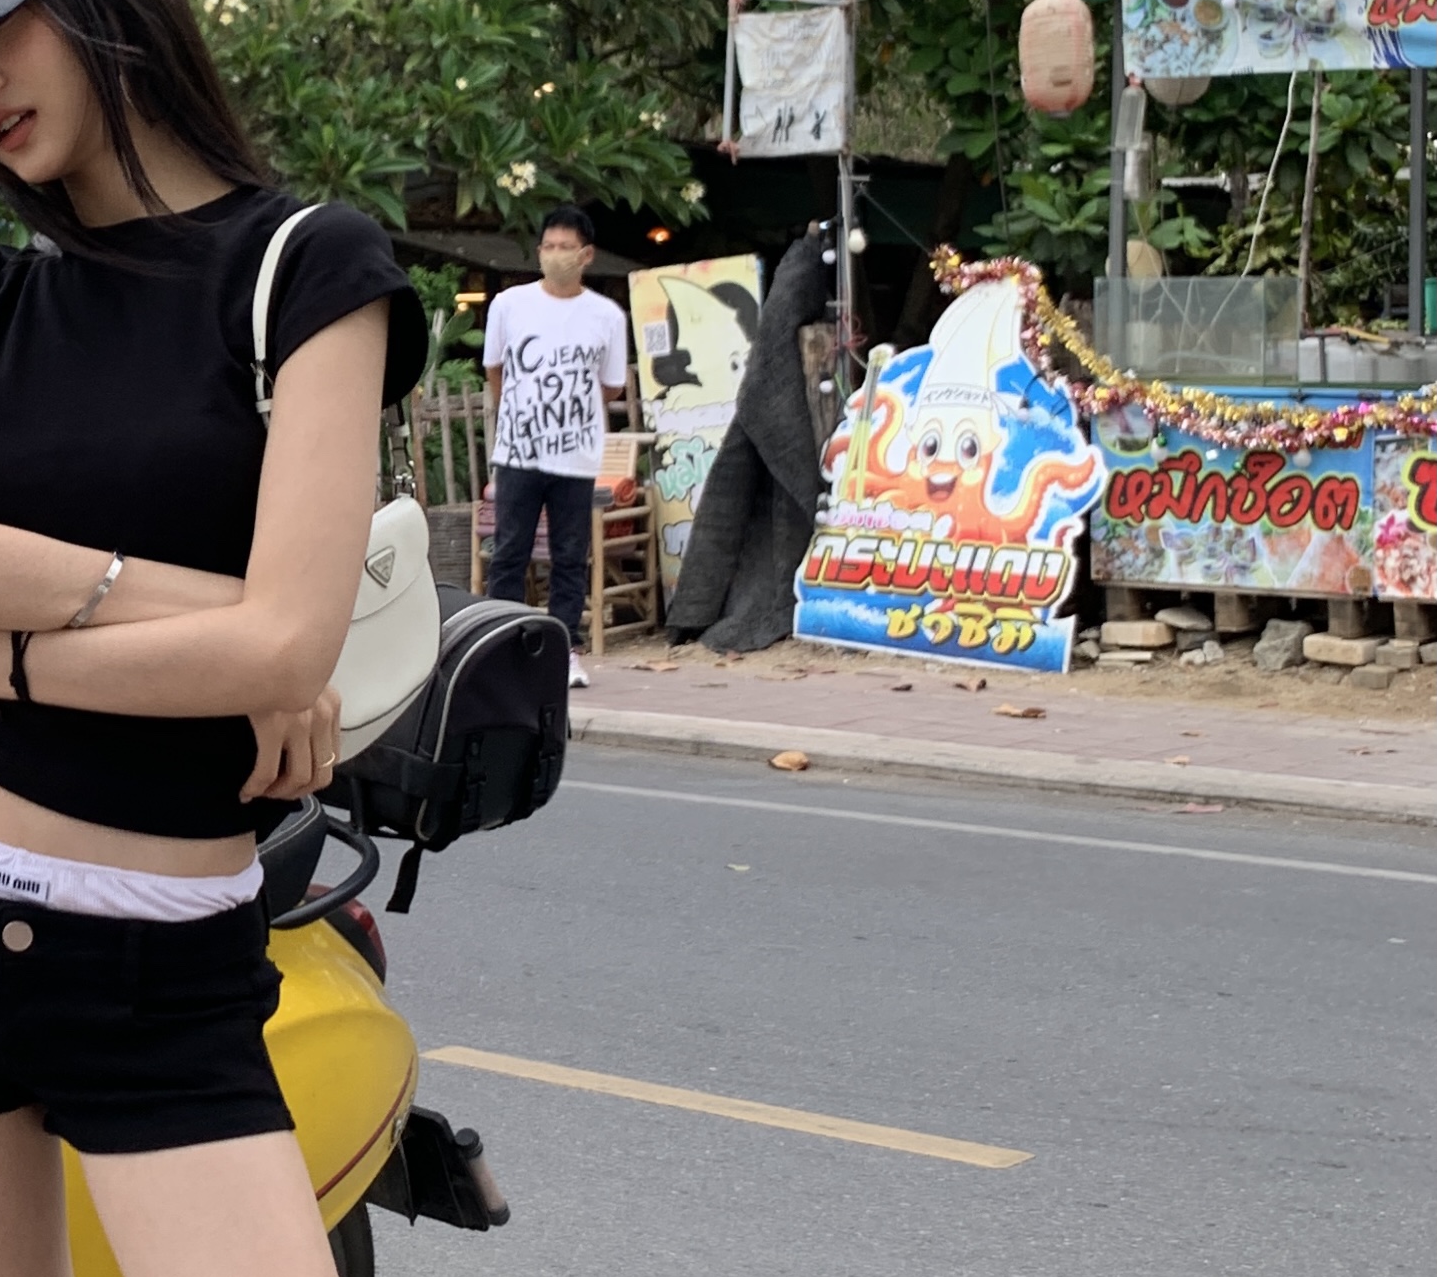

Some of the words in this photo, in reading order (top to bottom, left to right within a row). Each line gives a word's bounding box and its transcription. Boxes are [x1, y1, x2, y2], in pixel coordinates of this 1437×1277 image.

[533, 368, 594, 403] 1975
[1105, 449, 1361, 530] หมึกช็อต
[12, 877, 41, 895] miu
